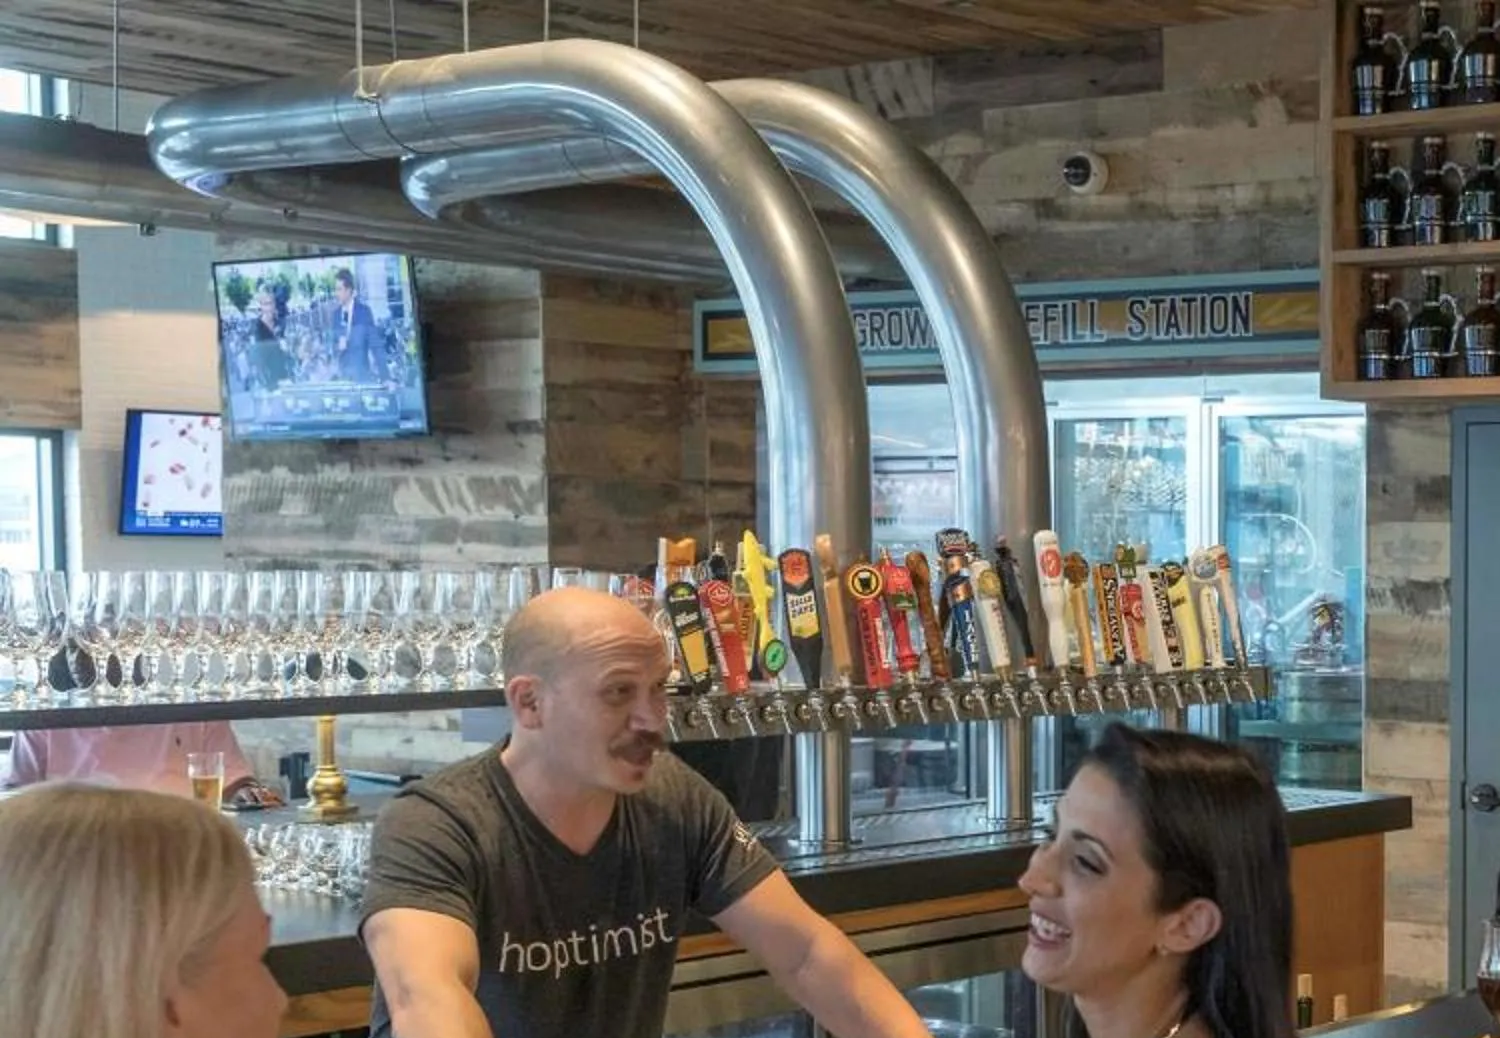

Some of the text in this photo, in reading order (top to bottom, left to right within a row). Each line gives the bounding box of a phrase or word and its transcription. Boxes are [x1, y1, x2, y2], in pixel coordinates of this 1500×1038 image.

[853, 292, 1252, 350] GROW EFILL STATION
